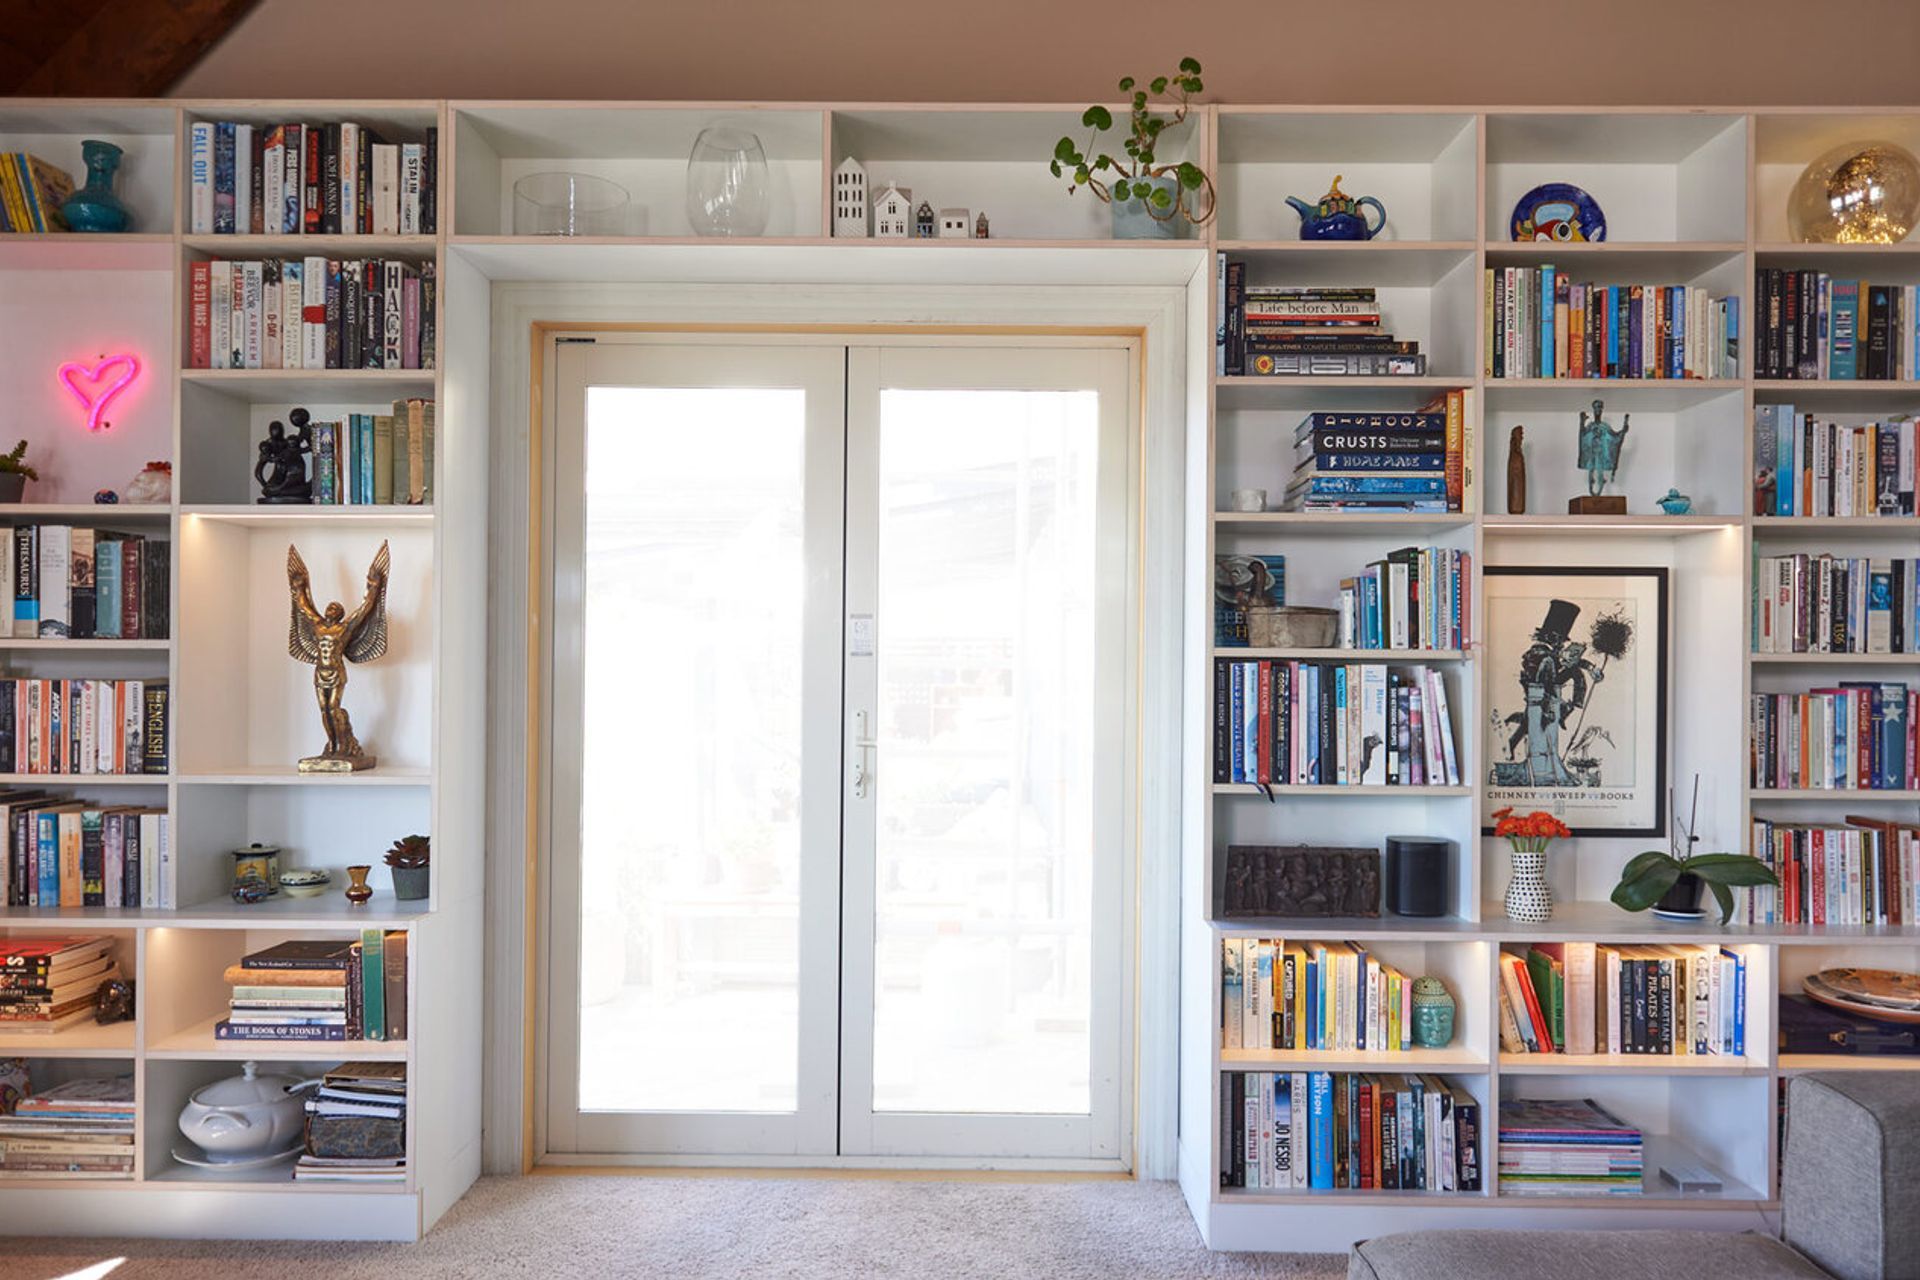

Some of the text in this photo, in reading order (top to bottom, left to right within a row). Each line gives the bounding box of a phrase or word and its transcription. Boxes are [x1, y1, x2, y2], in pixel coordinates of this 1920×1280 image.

[193, 128, 207, 185] FALL OUT
[328, 155, 338, 215] KOFI ANNAN
[408, 157, 419, 194] STALIN
[194, 267, 207, 327] THE 9/11 WARS
[246, 269, 258, 361] BEEVOR ARNHEM
[288, 283, 300, 326] BERLIN
[346, 280, 356, 325] CONQUEST
[1288, 303, 1327, 314] before
[1332, 303, 1359, 314] Man
[221, 306, 229, 350] HOLLAND
[266, 313, 278, 338] D-DAY
[1507, 306, 1515, 330] BITCH
[1573, 337, 1583, 368] 1968
[1324, 415, 1429, 428] DISHOOM
[1323, 435, 1388, 449] CRUSTS
[19, 536, 30, 597] THESAURUS
[1833, 623, 1846, 645] 1356
[85, 692, 93, 711] OUR
[1261, 686, 1270, 715] RECIPES
[1277, 671, 1285, 741] COOK with JAMIE
[148, 702, 164, 754] ENGLISH
[1487, 791, 1634, 801] CHIMNEY SWEEP BOOKS
[47, 849, 55, 873] BATTLE
[1285, 960, 1294, 1000] CAPTURED
[1647, 975, 1658, 1018] PIRATES
[233, 1026, 322, 1037] THE BOOK OF STONES
[1661, 996, 1670, 1042] MARTIAN
[1293, 1078, 1301, 1114] HARRIS
[1313, 1075, 1322, 1116] BRYSON
[1275, 1120, 1291, 1136] JO
[1383, 1126, 1391, 1144] LAST
[1383, 1145, 1391, 1169] EMPIRE
